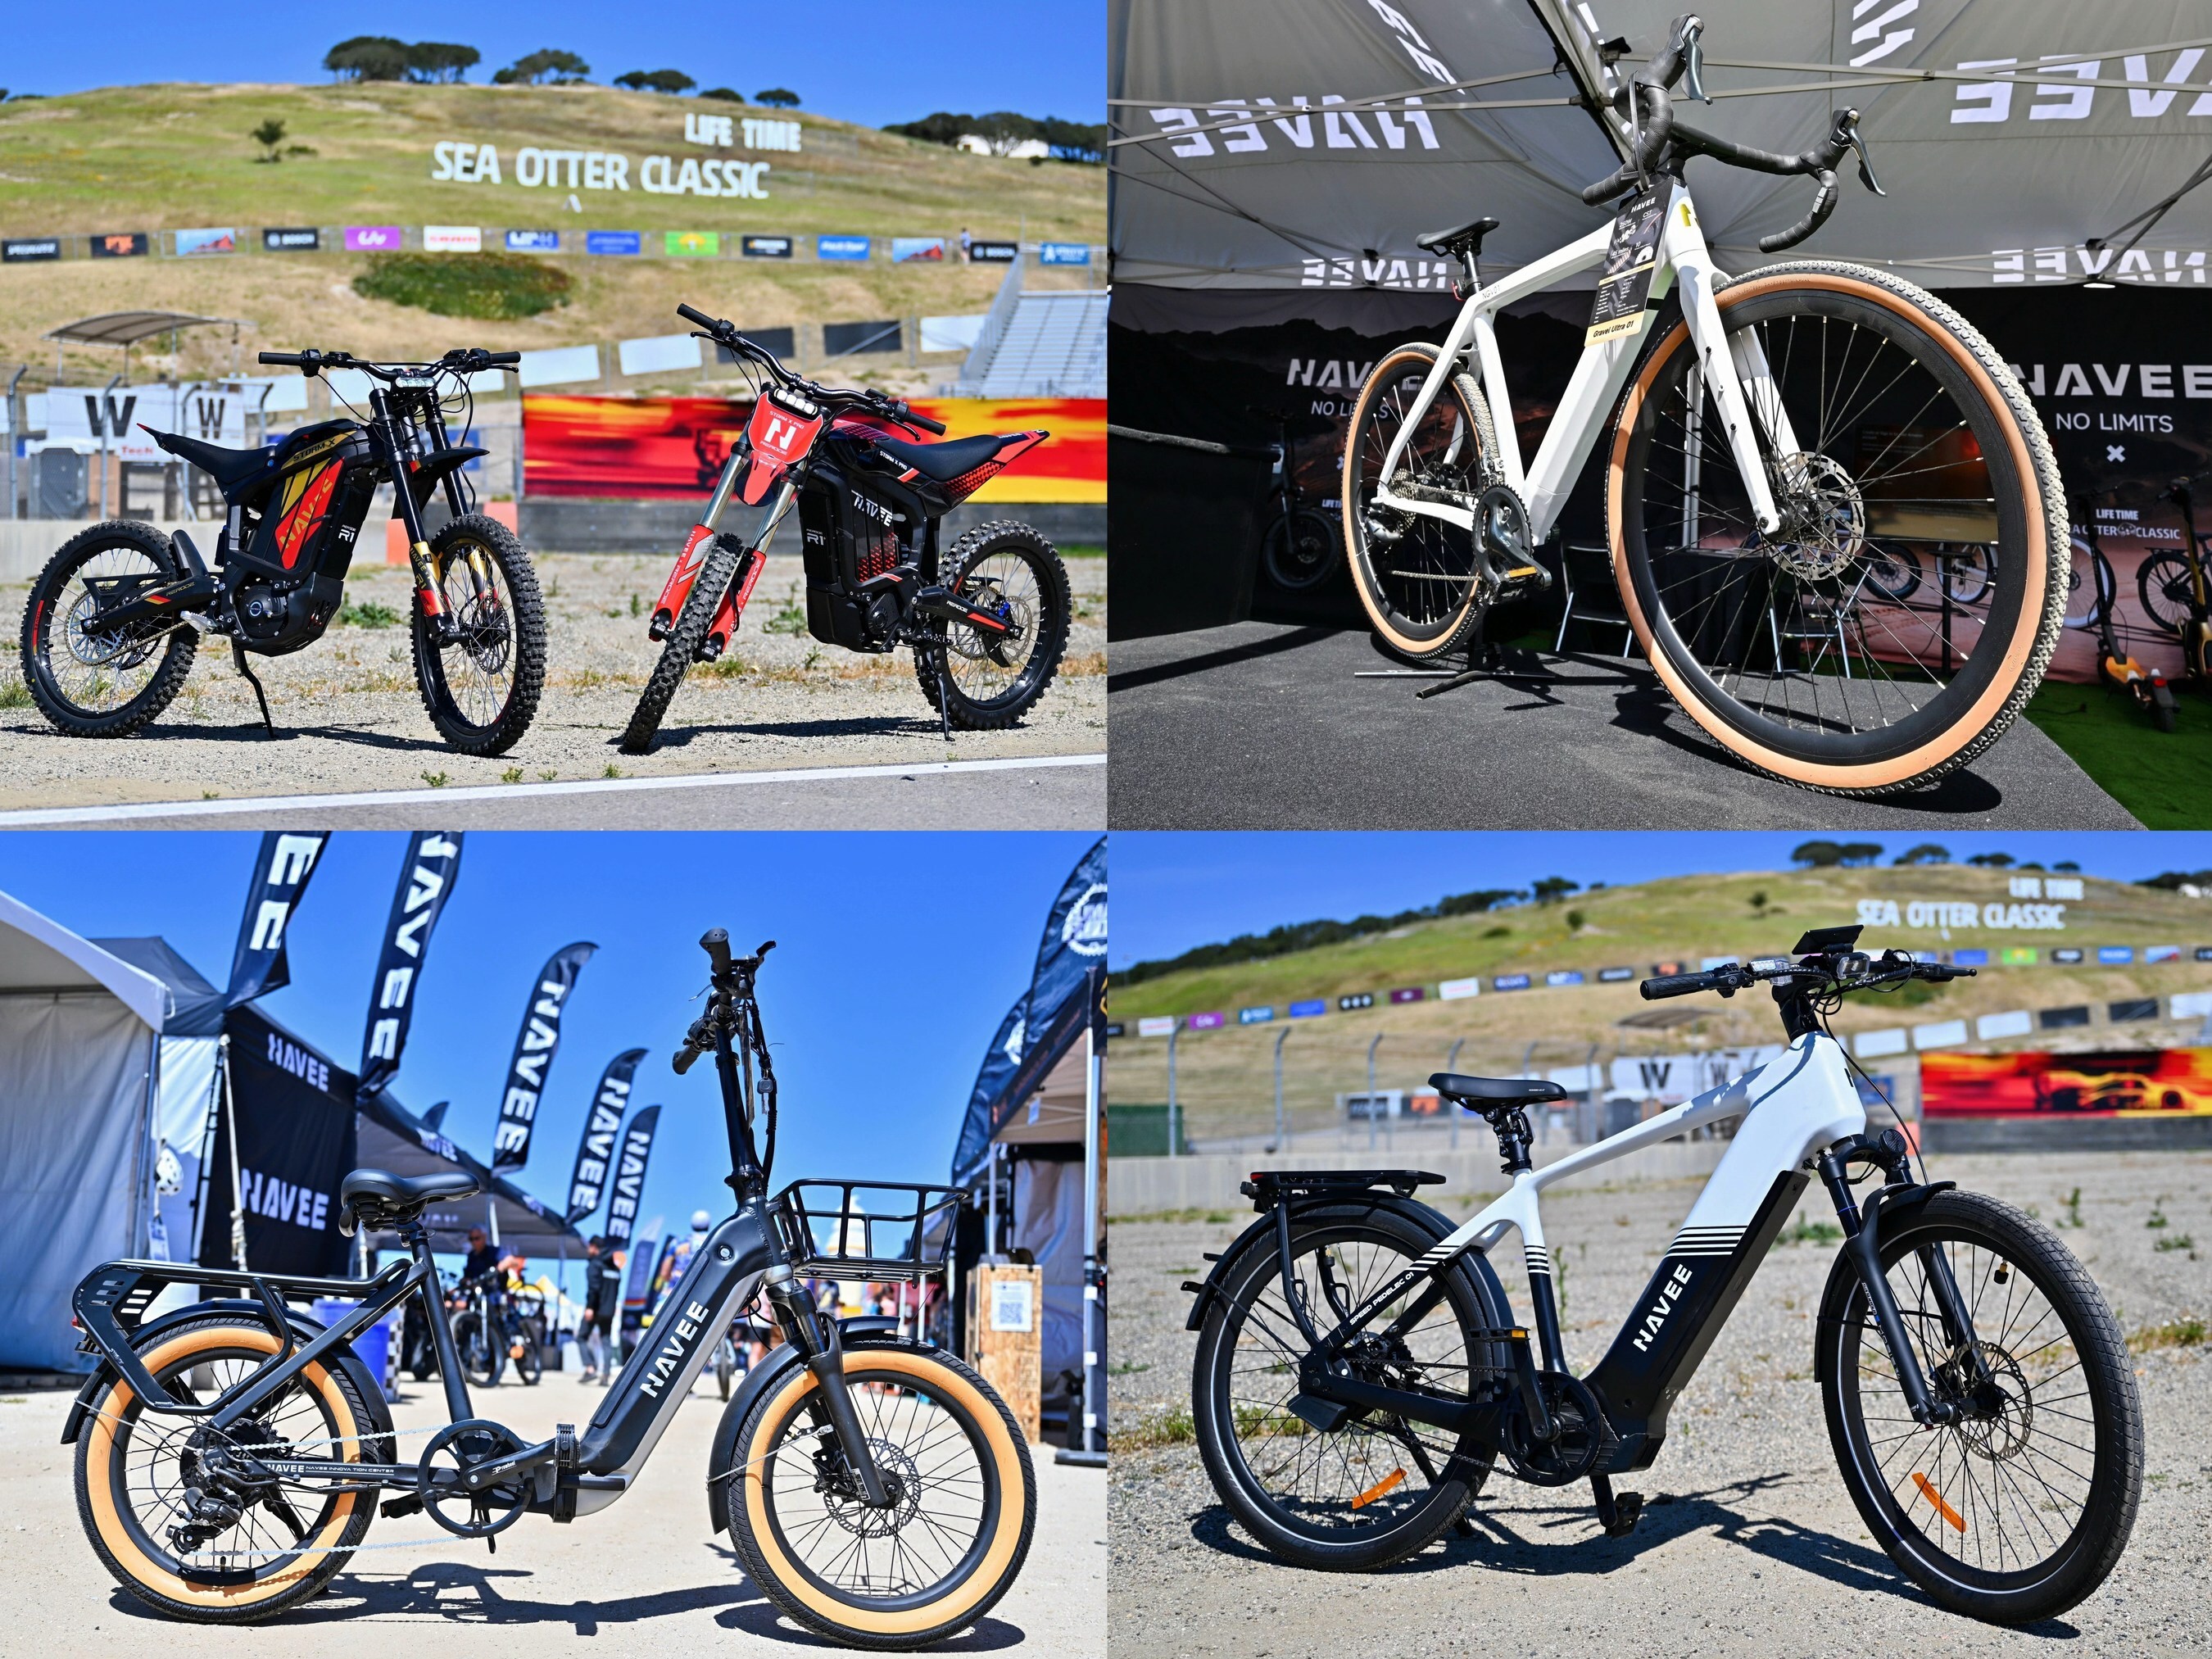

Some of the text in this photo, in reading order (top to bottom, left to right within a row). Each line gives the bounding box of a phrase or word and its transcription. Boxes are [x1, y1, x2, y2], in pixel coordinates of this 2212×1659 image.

[685, 113, 802, 152] LIFE TIME
[432, 140, 771, 199] SEA OTTER CLASSIC
[1631, 197, 1656, 213] NAVEE
[1593, 320, 1634, 338] Gravel Ultra 01
[84, 395, 137, 437] W
[197, 397, 225, 439] W
[769, 410, 788, 422] STORM
[1311, 401, 1335, 416] NO
[2056, 413, 2173, 433] NO LIMITS
[293, 438, 337, 464] STORM X
[879, 451, 895, 463] STORM
[2096, 509, 2139, 520] LIFE TIME
[338, 528, 355, 542] R1
[682, 530, 696, 558] NAVEE
[2136, 527, 2180, 539] CLASSIC
[1856, 899, 2066, 930] SEA OTTER CLASSIC
[267, 1032, 329, 1093] NAVEE
[494, 980, 566, 1154] NAVEE
[1639, 1063, 1671, 1089] W
[571, 1077, 631, 1210] NAVEE
[240, 1167, 329, 1231] NAVEE
[608, 1130, 650, 1240] NAVEE
[1349, 1271, 1414, 1326] SPEED PEDELEC 01
[1633, 1263, 1693, 1352] NAVEE
[640, 1301, 709, 1398] NAVEE
[267, 1463, 304, 1473] NAVEE
